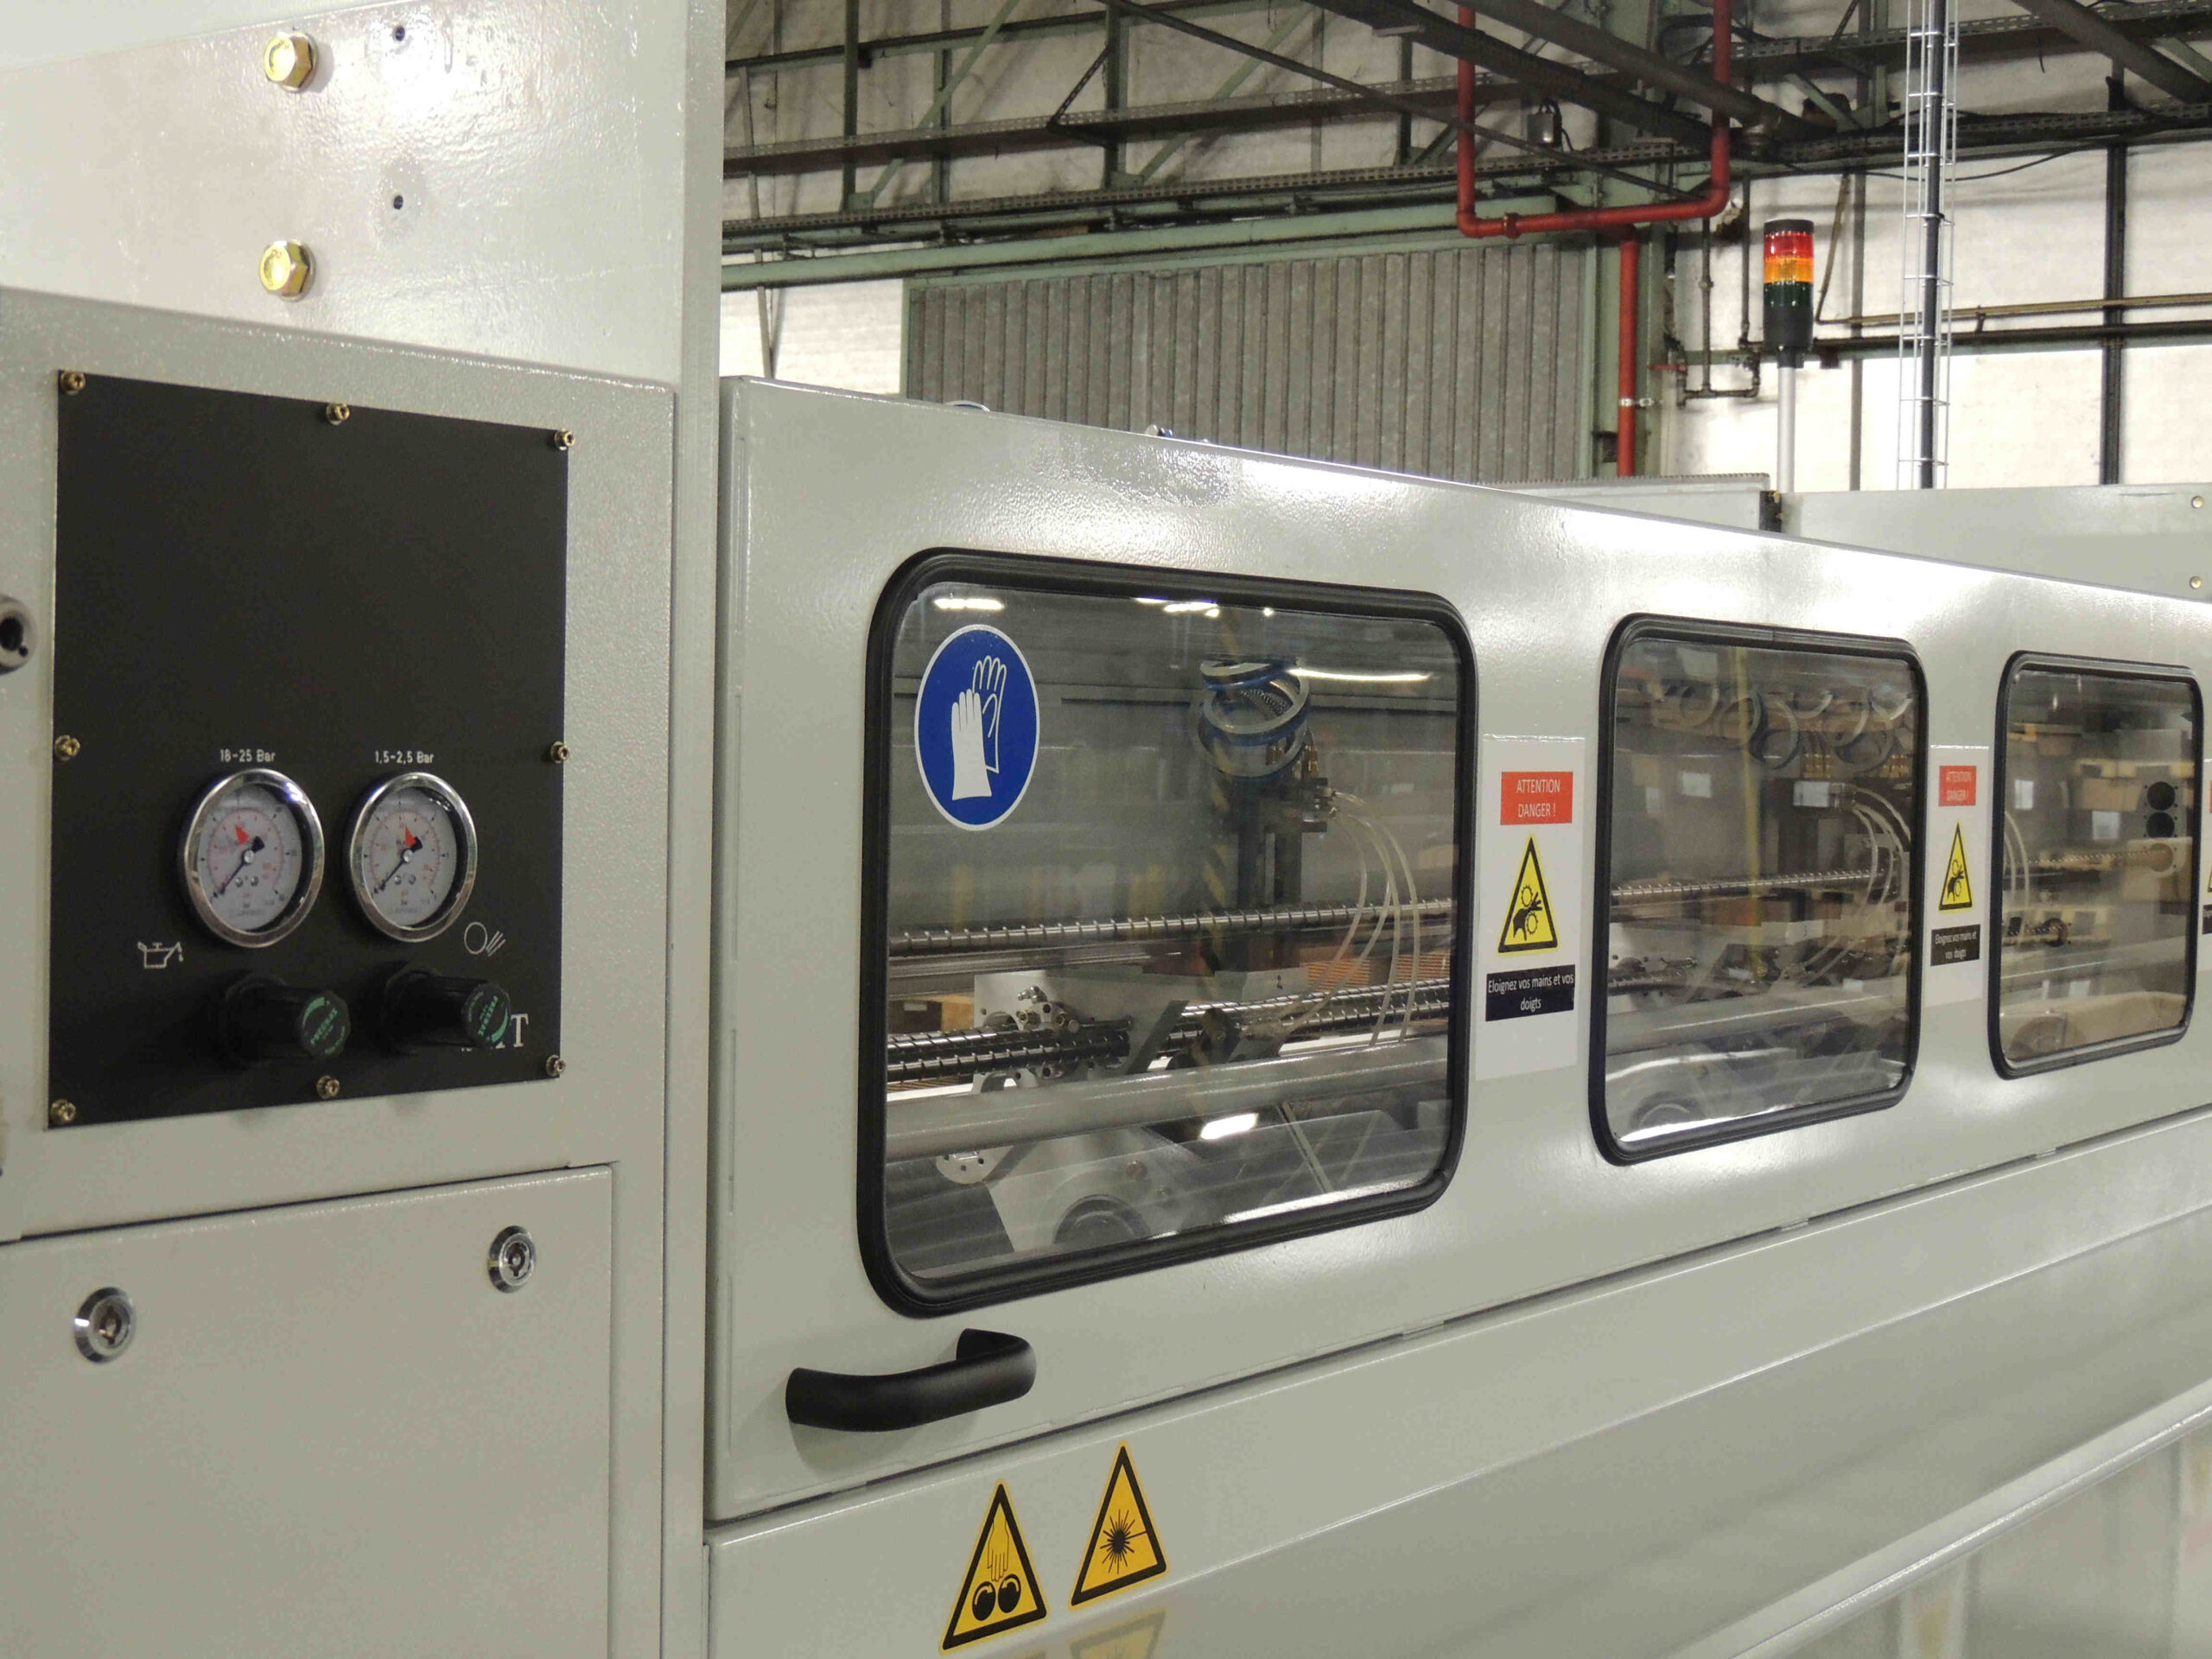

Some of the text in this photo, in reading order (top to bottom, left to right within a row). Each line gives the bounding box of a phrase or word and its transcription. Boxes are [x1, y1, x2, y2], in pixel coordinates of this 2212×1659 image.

[257, 748, 276, 762] Bar
[416, 750, 434, 764] Bar
[1516, 779, 1560, 793] ATTENTION
[1518, 804, 1551, 817] DANGER
[1488, 974, 1574, 995] Eloignez vos mains et vos
[1521, 997, 1541, 1012] doigts
